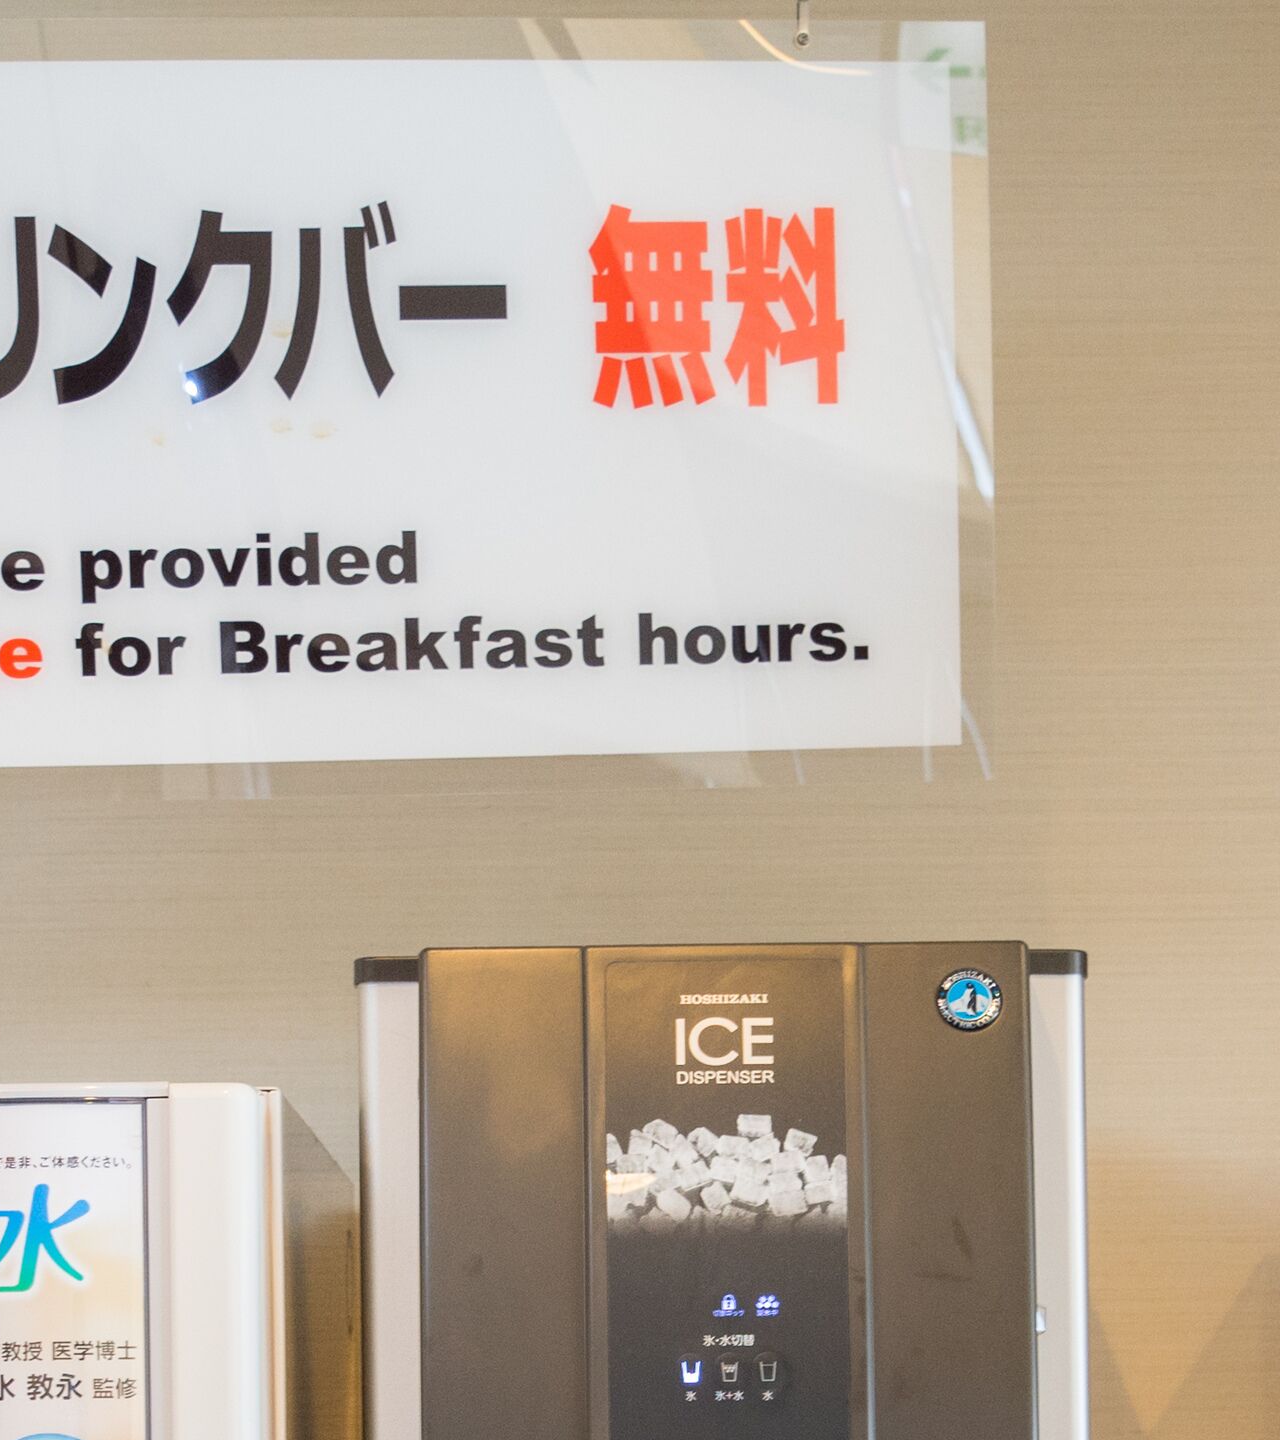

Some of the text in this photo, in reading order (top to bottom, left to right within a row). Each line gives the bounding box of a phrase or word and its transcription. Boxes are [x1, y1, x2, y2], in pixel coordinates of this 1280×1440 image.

[588, 203, 845, 409] 無料
[79, 530, 418, 604] provided
[75, 623, 186, 677] for
[220, 614, 604, 674] Breakfast
[637, 611, 869, 665] hours.
[680, 993, 768, 1005] HOSHIZAKI
[675, 1016, 775, 1066] ICE
[676, 1069, 775, 1085] DISPENSER
[52, 1341, 137, 1361] 医学博士
[702, 1334, 755, 1346] 氷・水切替
[27, 1373, 83, 1400] 教永
[92, 1378, 137, 1400] 監修
